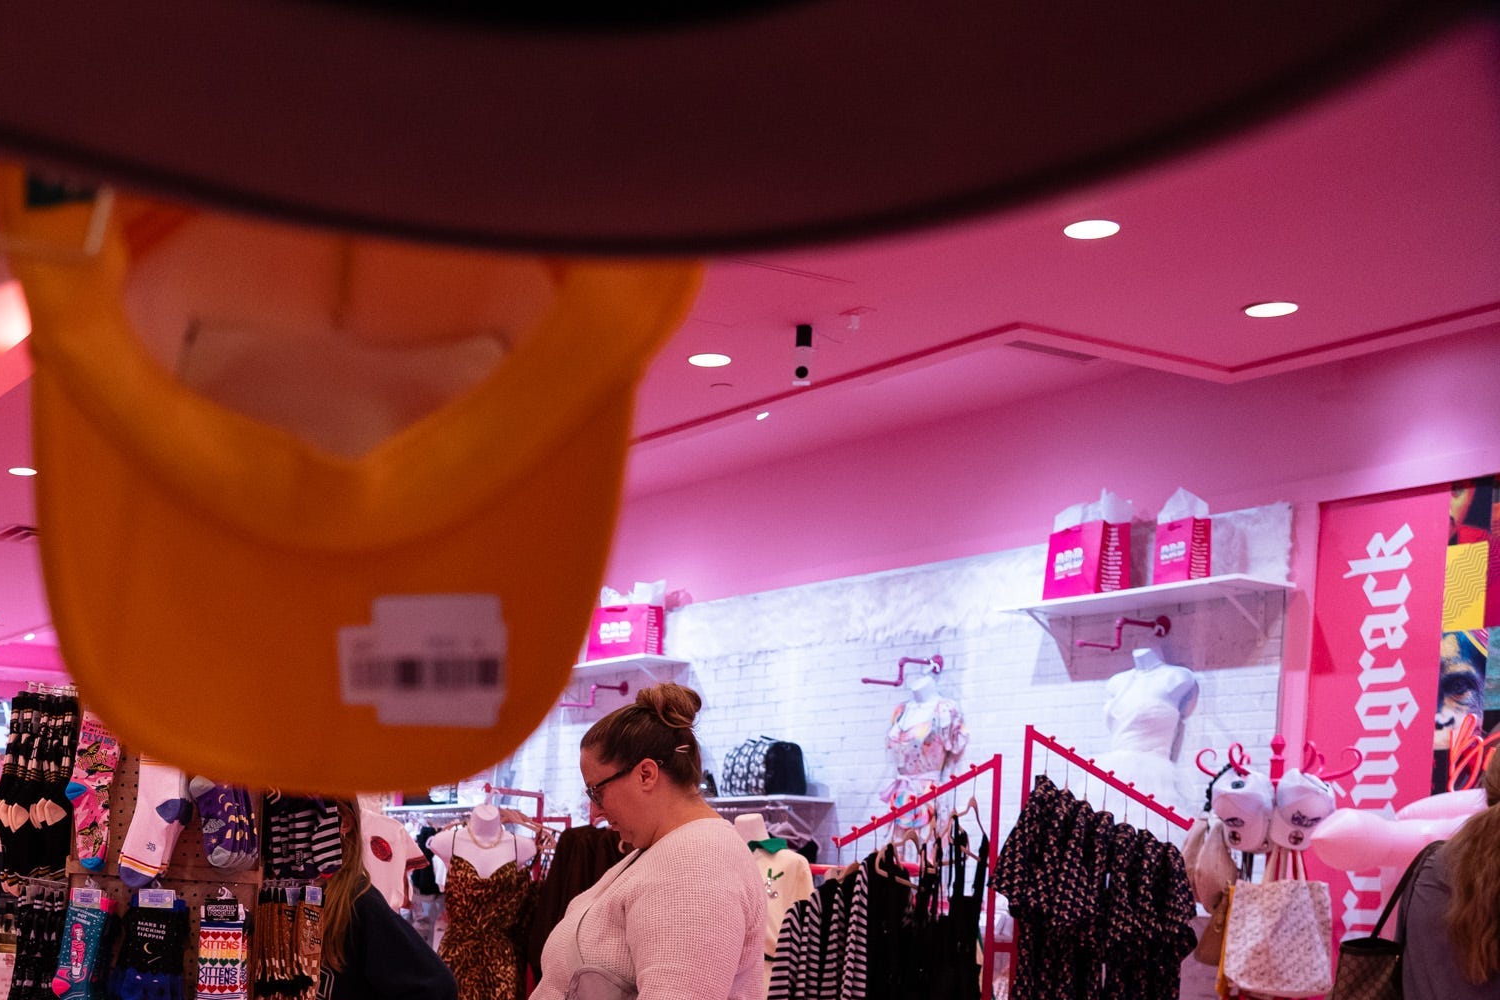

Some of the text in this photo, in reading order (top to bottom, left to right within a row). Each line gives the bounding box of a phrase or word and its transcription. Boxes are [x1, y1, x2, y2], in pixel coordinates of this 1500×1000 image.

[81, 731, 117, 746] FLYING
[137, 926, 166, 935] FUCKING
[137, 931, 164, 940] HAPPEN
[199, 940, 240, 950] KITTENS
[199, 950, 238, 959] KITTENS
[198, 966, 238, 977] KITTENS
[198, 975, 237, 985] KITTENS
